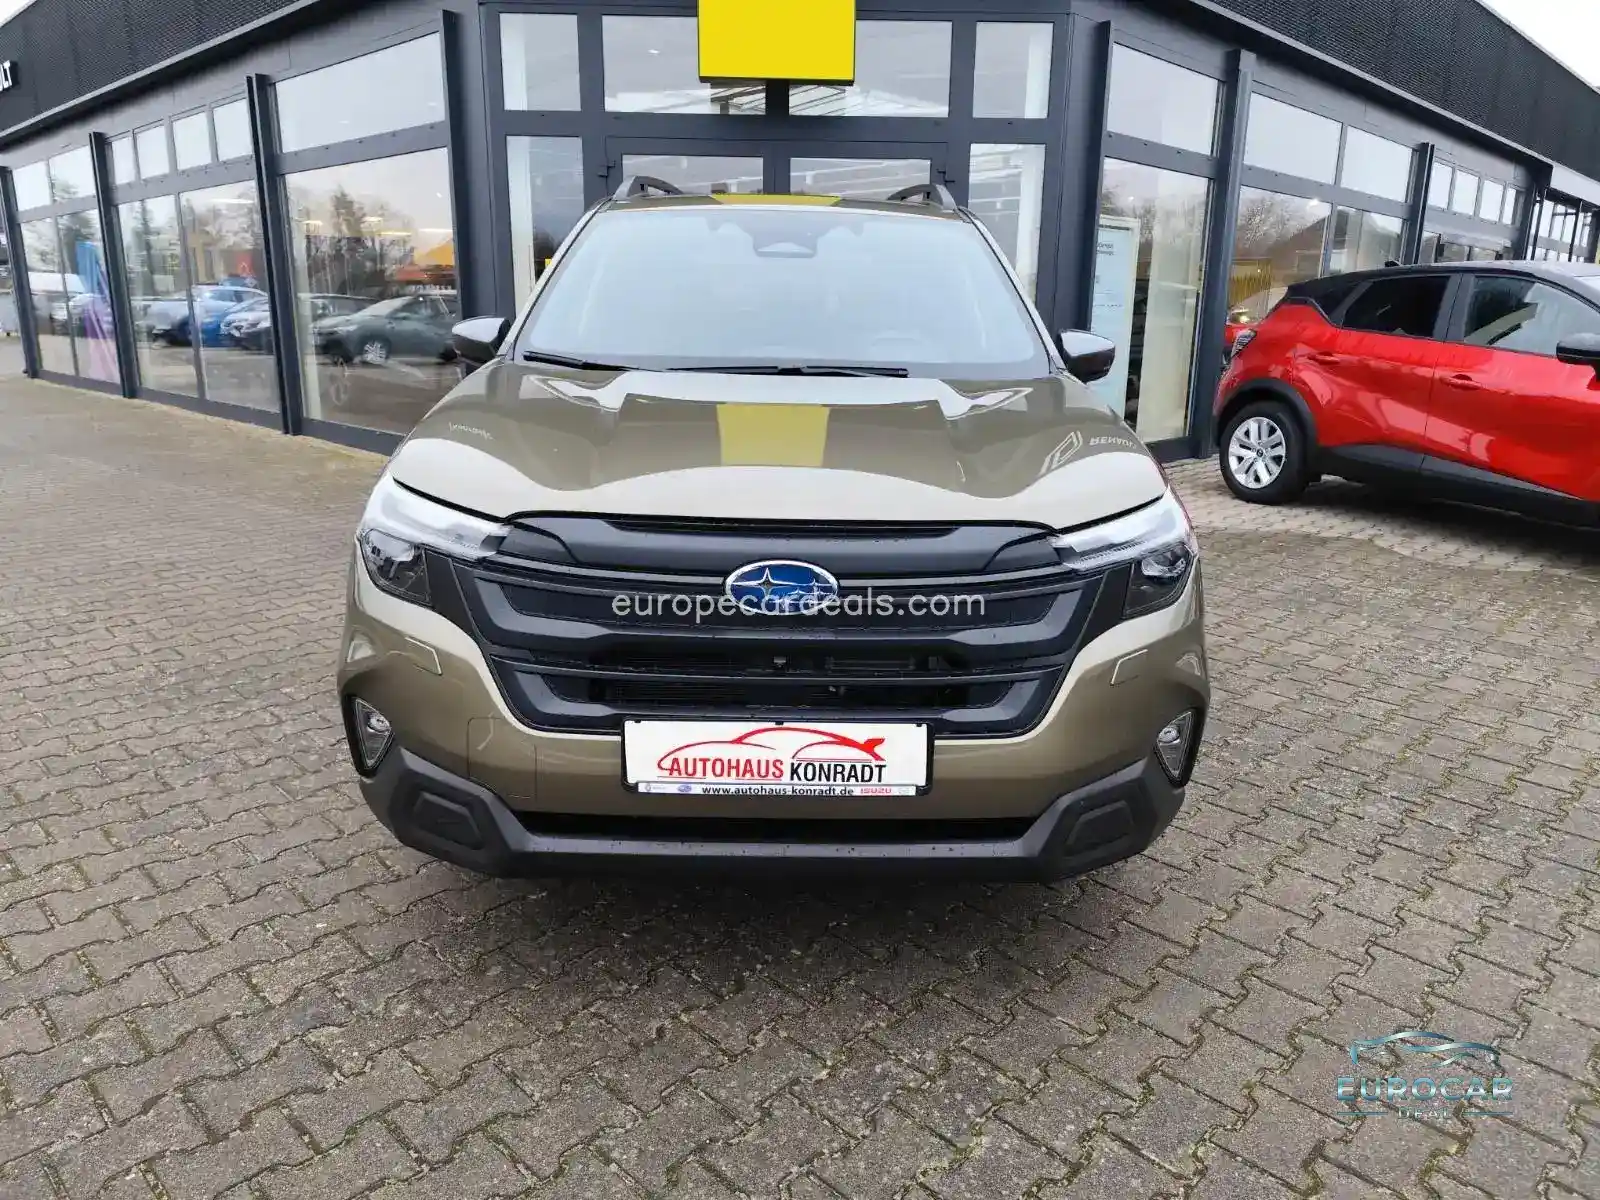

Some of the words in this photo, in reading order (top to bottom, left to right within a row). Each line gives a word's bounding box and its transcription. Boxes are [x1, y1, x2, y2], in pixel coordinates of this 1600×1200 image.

[668, 757, 784, 779] AUTOHAUS
[789, 762, 887, 783] KONRADT
[701, 785, 854, 796] www.autohaus-konradt.de
